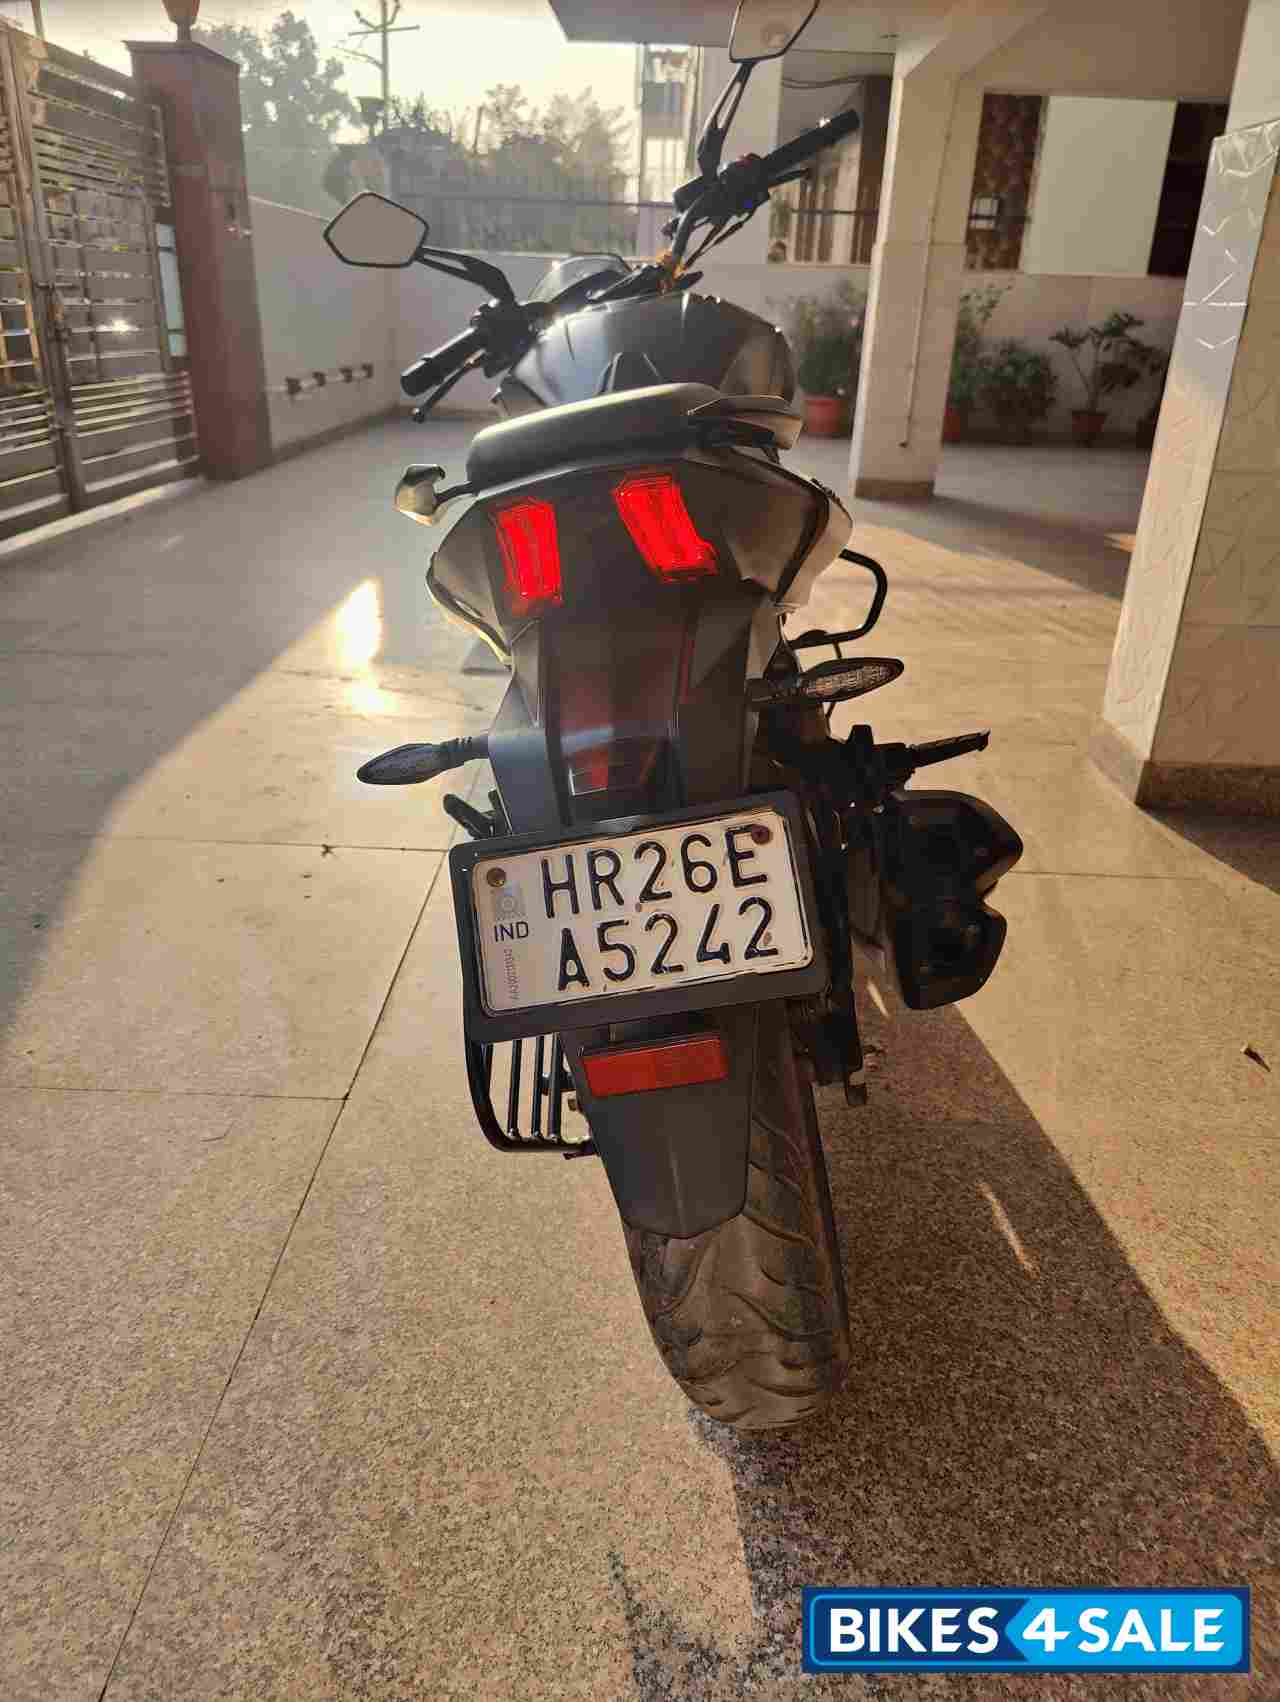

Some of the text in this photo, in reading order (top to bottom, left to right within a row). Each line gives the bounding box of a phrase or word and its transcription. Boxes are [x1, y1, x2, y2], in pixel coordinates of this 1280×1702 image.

[540, 824, 768, 919] HR26E
[494, 921, 529, 942] IND
[558, 896, 780, 992] A5242
